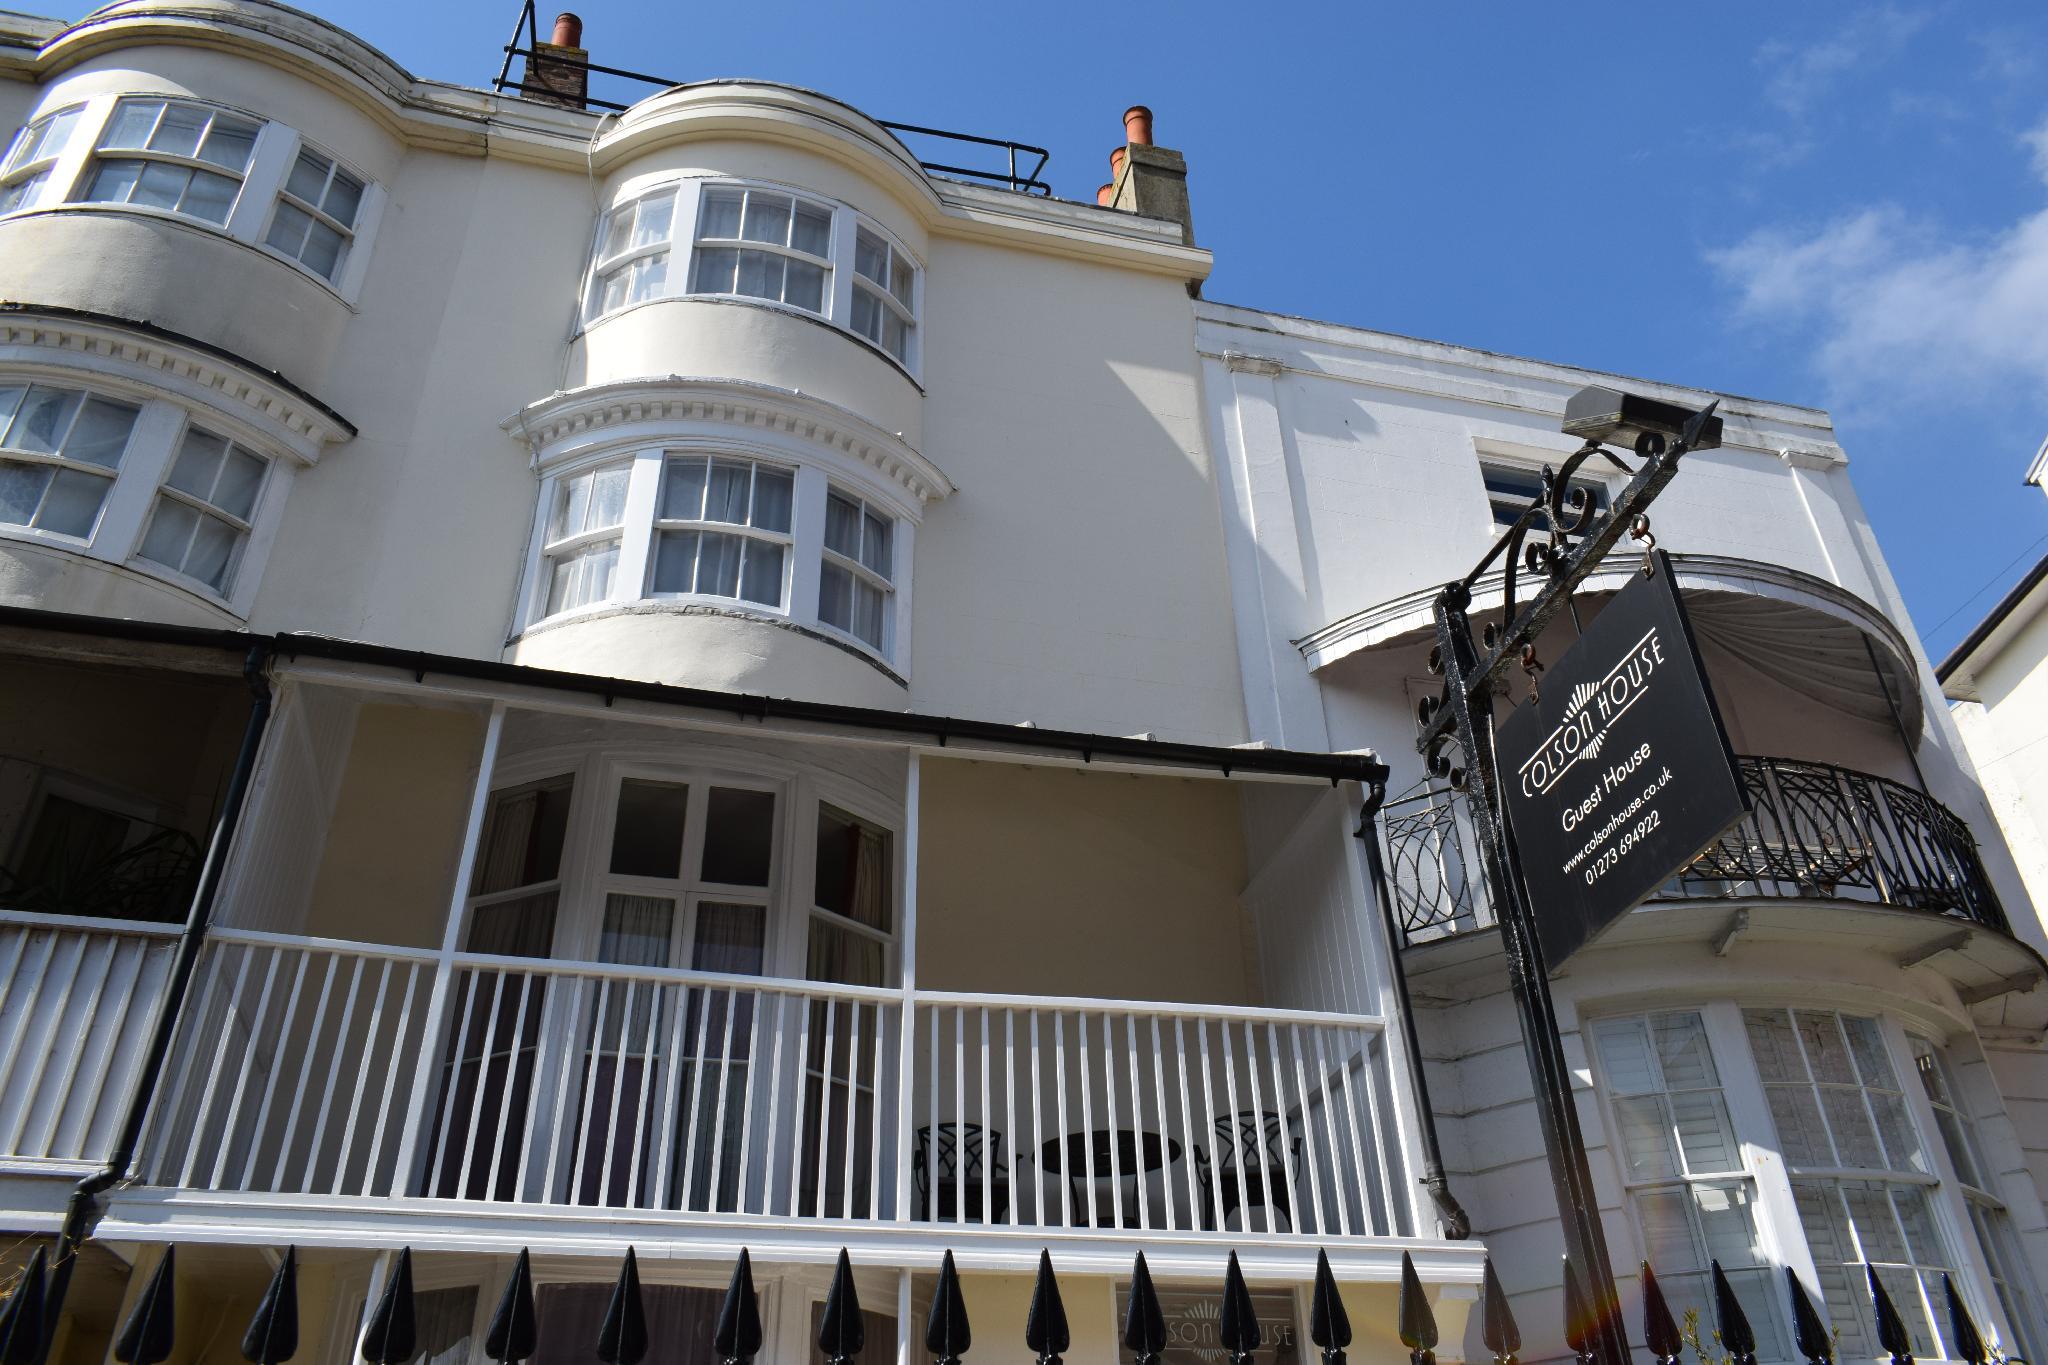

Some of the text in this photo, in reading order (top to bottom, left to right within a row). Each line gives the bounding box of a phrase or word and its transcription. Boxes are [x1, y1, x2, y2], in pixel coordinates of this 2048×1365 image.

[1522, 636, 1665, 798] COLSON HOUSE
[1562, 743, 1651, 832] Guest House
[1562, 766, 1673, 874] www.colsonhouse.co.uk
[1585, 810, 1661, 885] 01273 694922
[1169, 1321, 1292, 1346] SON USE
